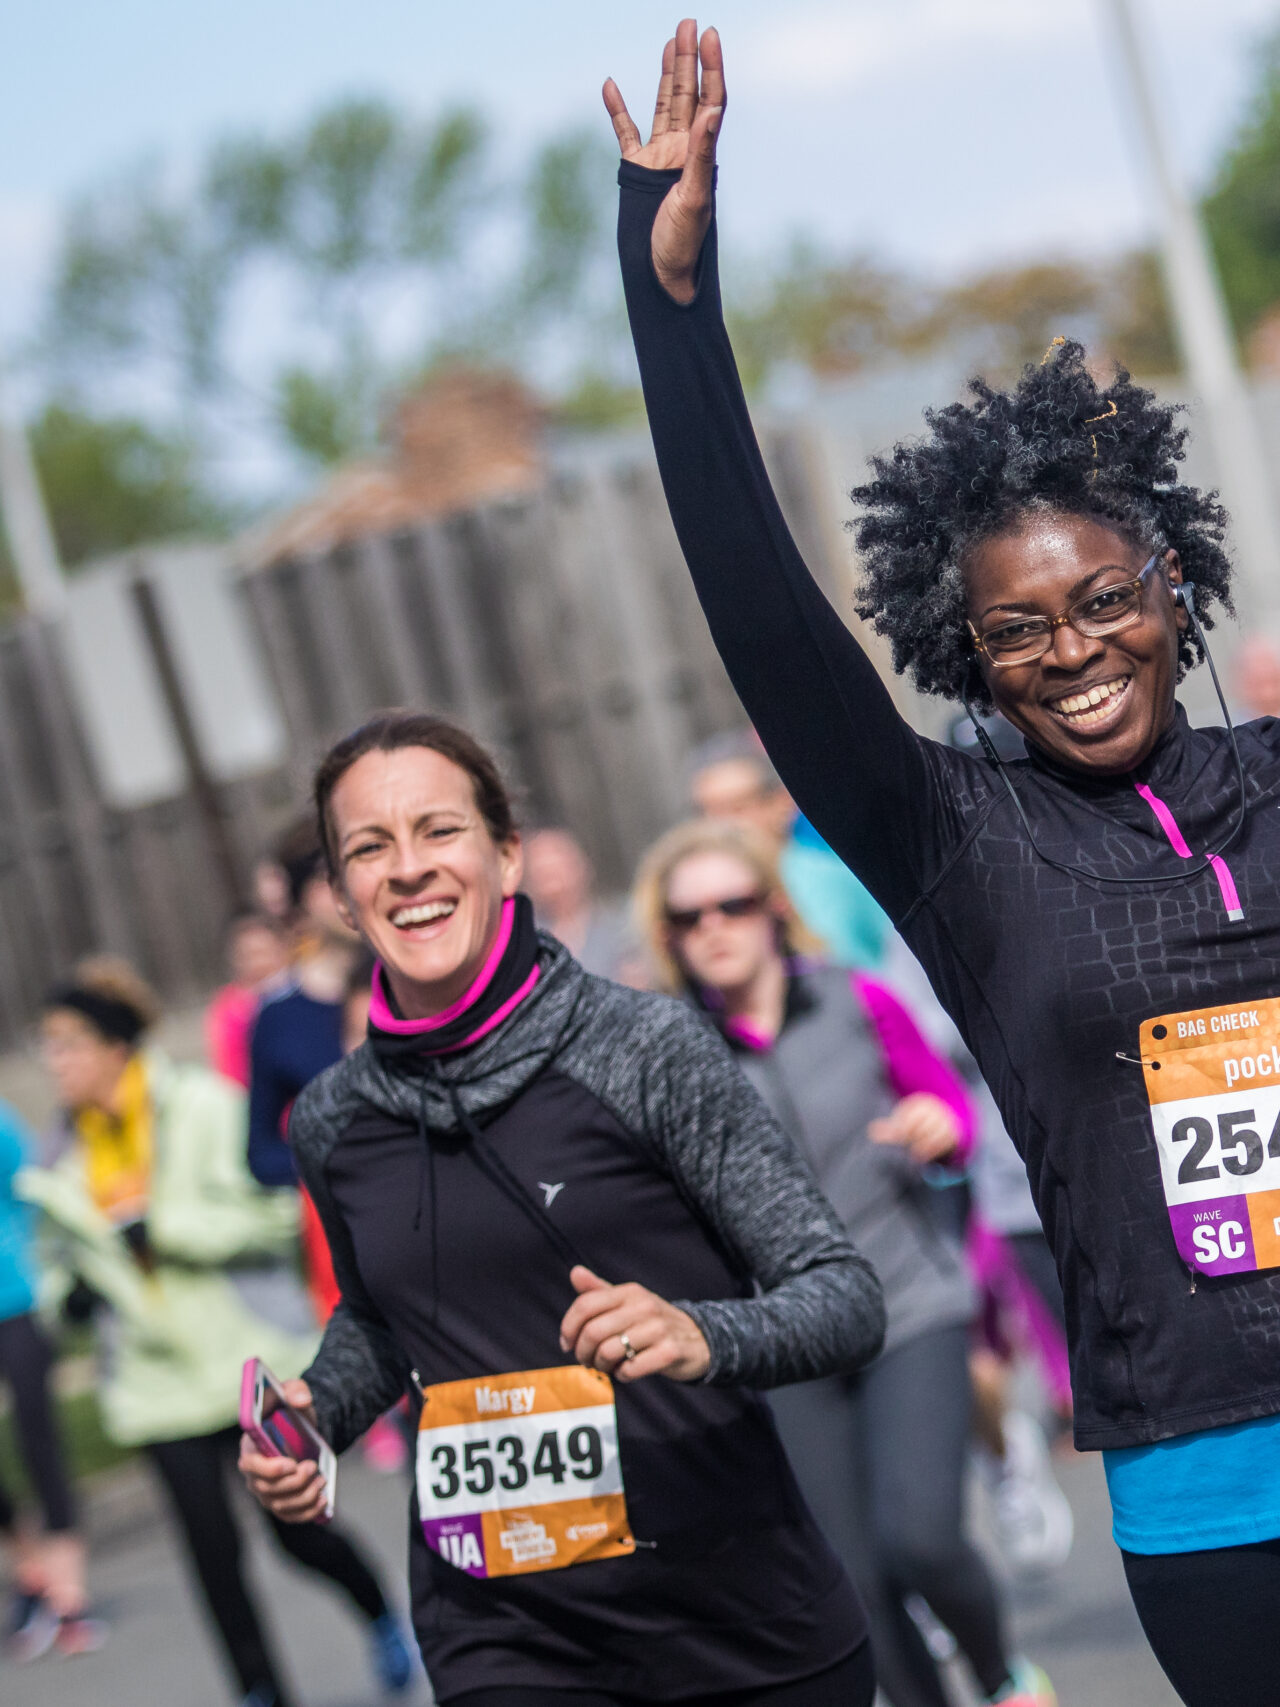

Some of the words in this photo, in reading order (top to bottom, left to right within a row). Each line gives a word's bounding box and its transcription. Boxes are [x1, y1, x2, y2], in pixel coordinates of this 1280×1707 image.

[1177, 1019, 1207, 1039] BAG
[1211, 1010, 1261, 1033] CHECK
[1193, 1209, 1223, 1224] WAVE
[1192, 1220, 1246, 1264] SC
[474, 1385, 536, 1415] Margy
[431, 1426, 604, 1499] 35349
[438, 1532, 484, 1570] UA
